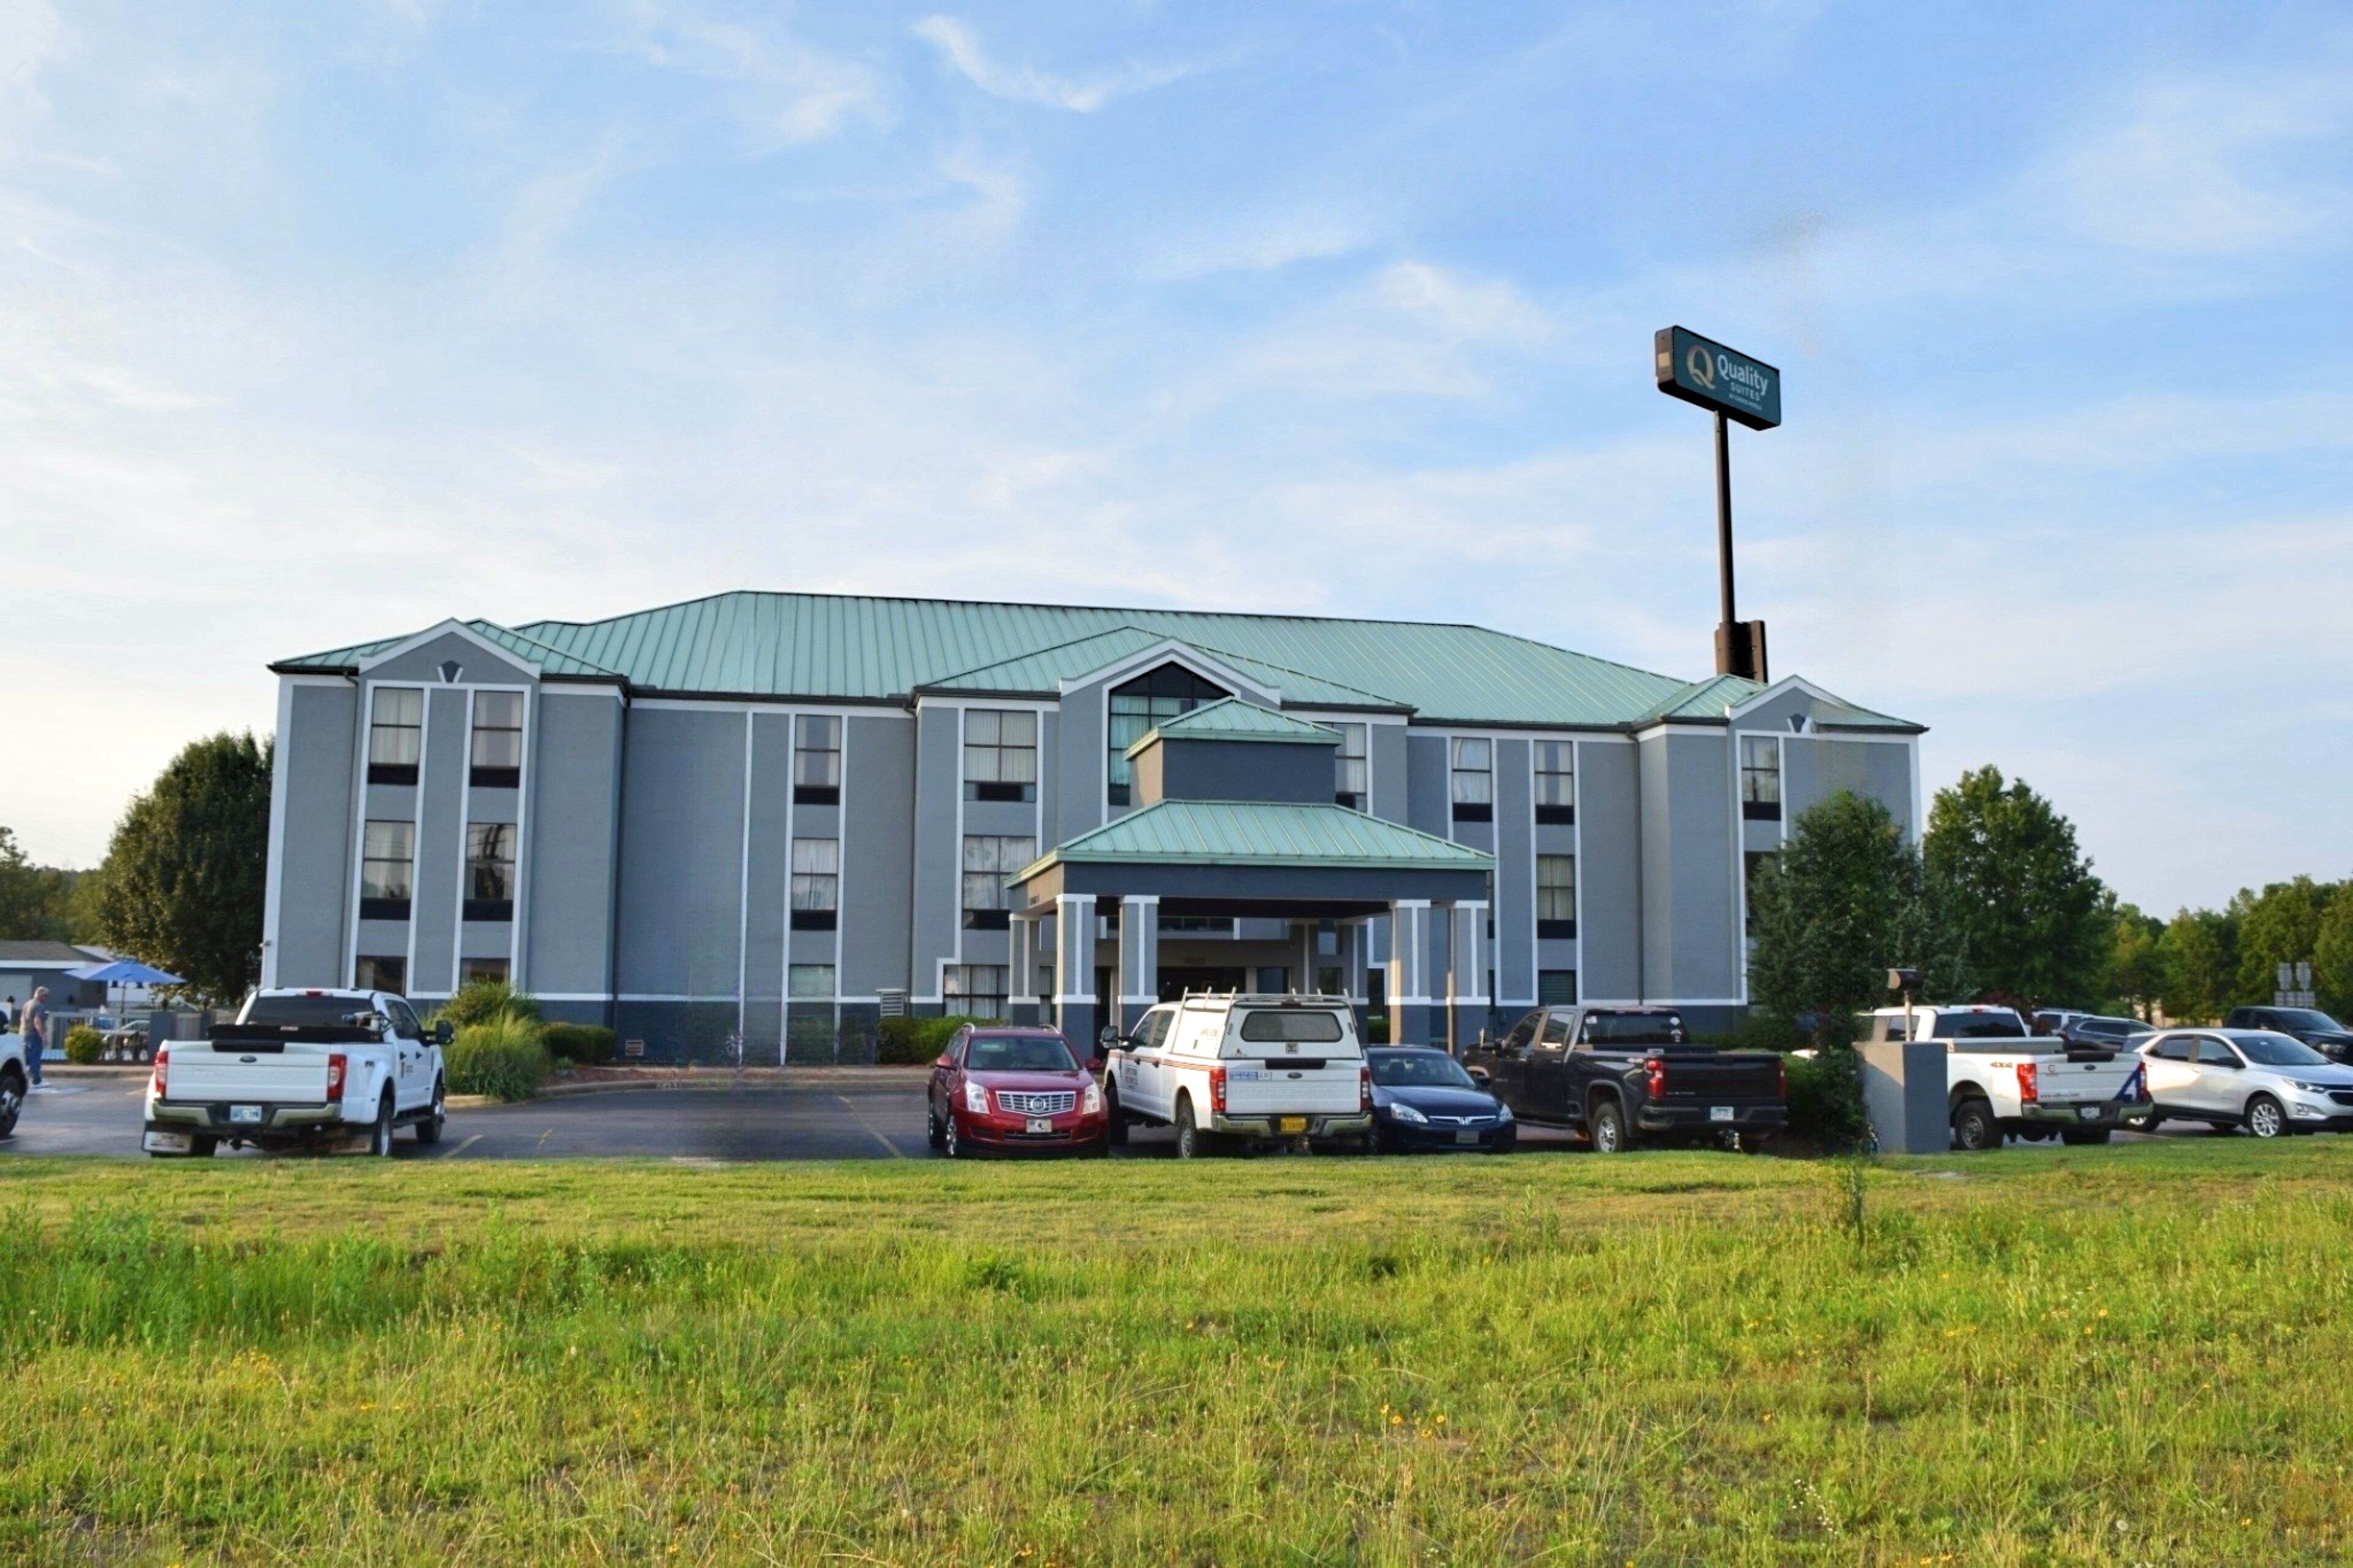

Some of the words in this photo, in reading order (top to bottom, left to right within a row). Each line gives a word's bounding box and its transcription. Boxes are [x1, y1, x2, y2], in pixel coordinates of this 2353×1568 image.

[1687, 345, 1716, 390] Q
[1718, 354, 1768, 396] Quality
[1730, 382, 1760, 401] SUITES
